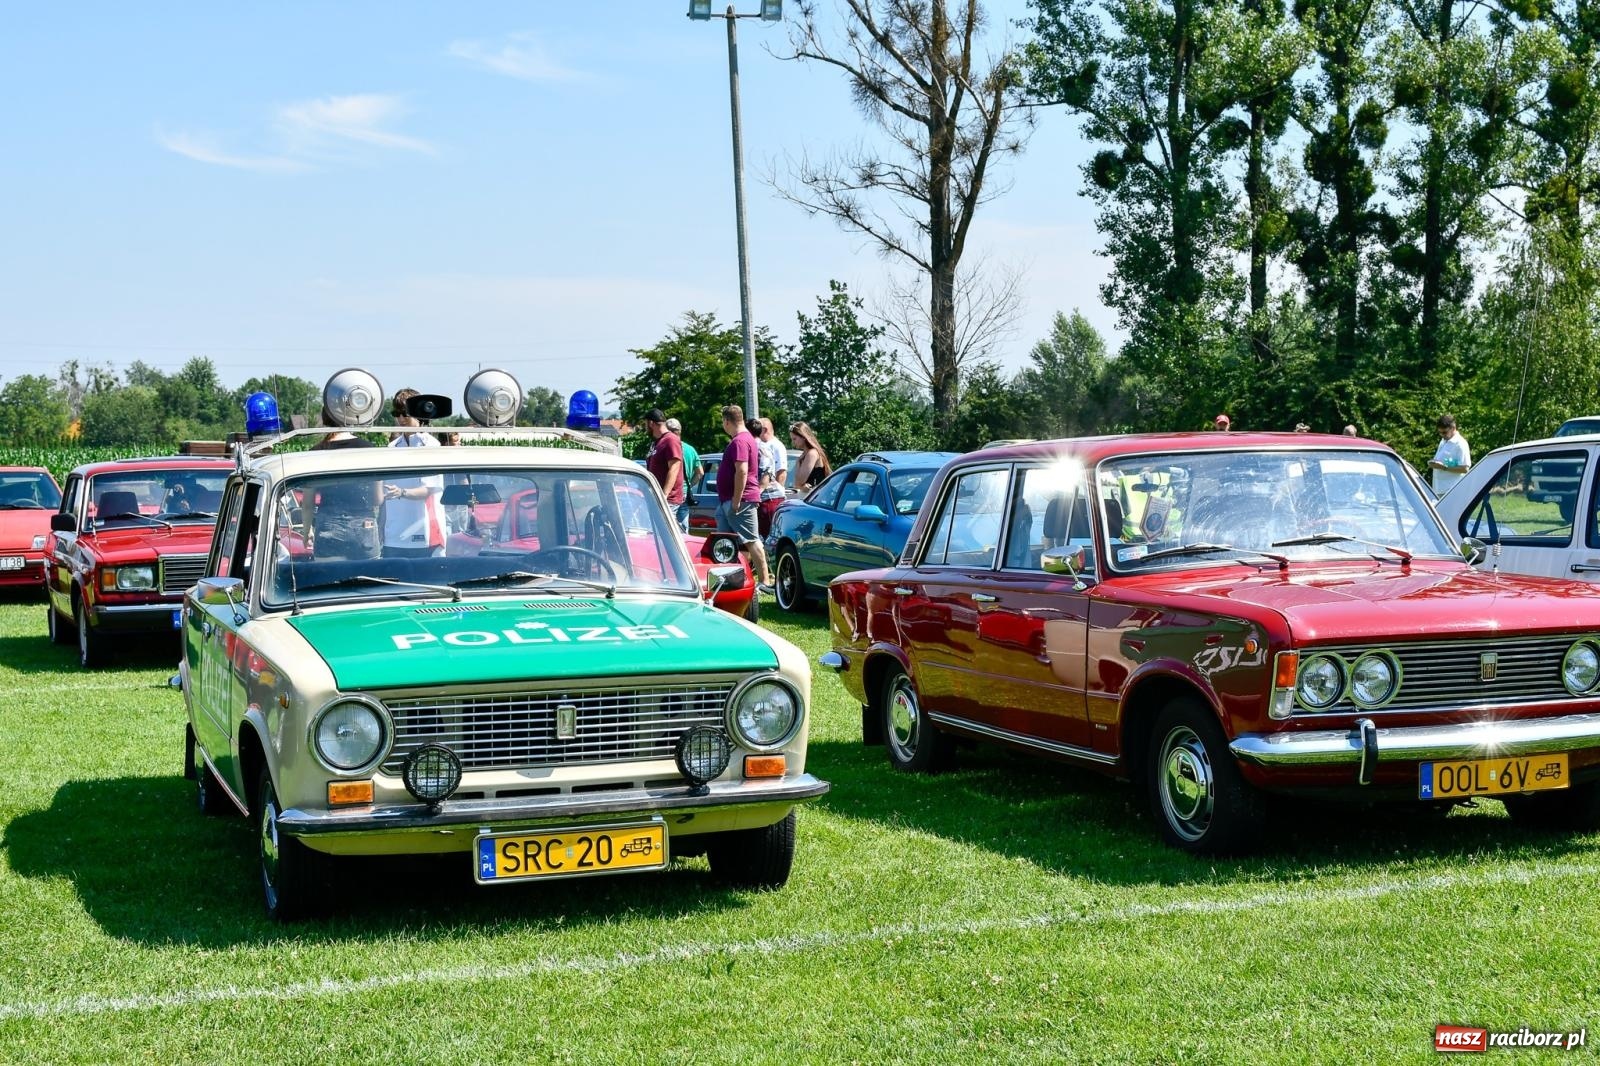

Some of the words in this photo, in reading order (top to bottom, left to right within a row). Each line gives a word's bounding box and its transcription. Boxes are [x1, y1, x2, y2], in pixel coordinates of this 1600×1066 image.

[391, 624, 690, 650] POLIZEI
[1500, 760, 1529, 789] 6V
[1421, 784, 1432, 793] PL
[502, 838, 564, 873] SRC
[576, 834, 613, 868] 20
[482, 863, 495, 873] PL
